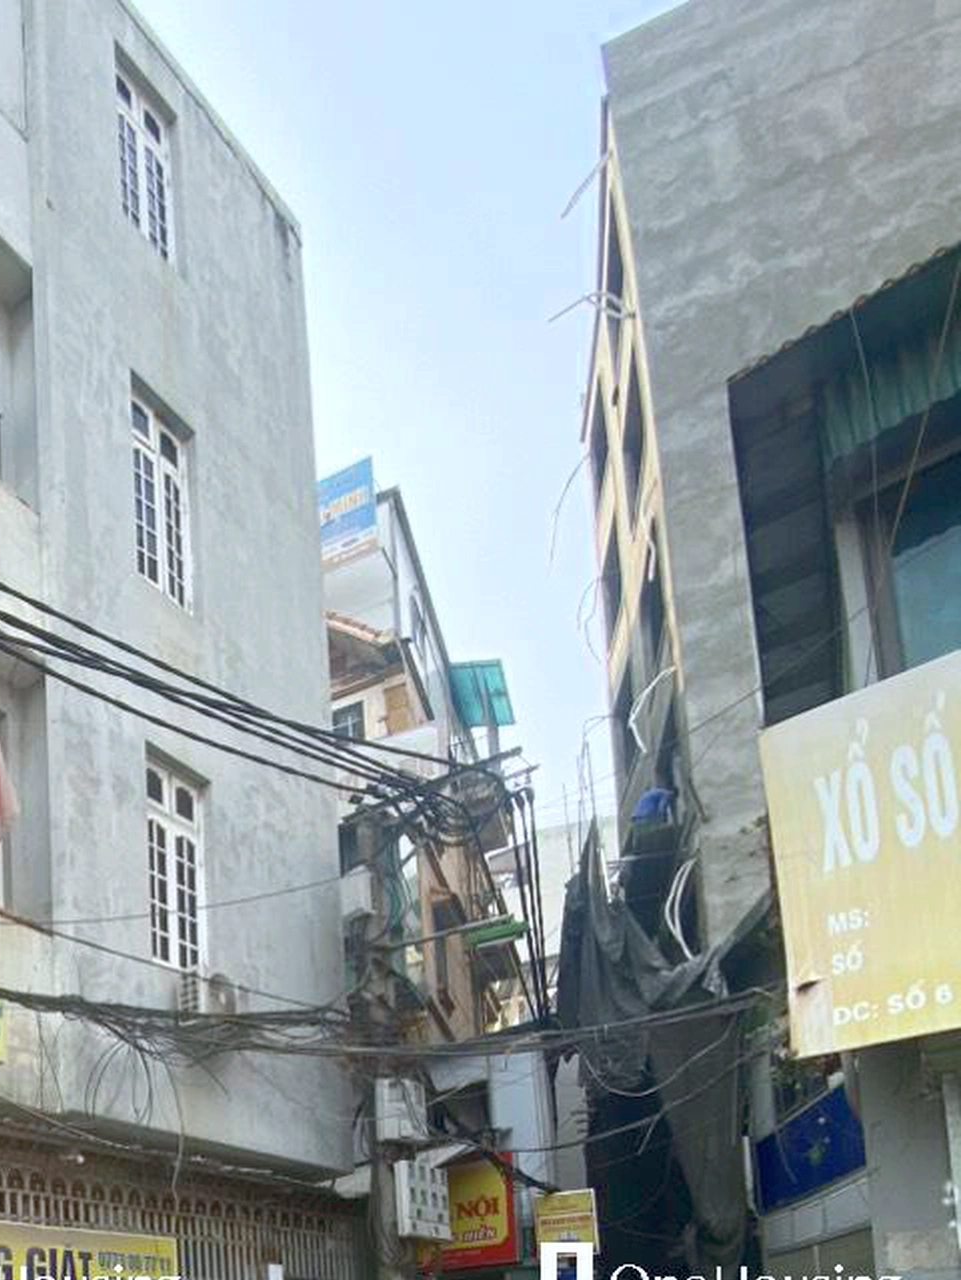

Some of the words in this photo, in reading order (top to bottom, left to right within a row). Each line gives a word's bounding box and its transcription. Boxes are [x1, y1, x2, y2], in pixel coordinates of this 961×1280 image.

[813, 717, 880, 873] XỔ
[890, 691, 959, 848] SỐ
[827, 908, 870, 937] MS:
[934, 983, 953, 1006] 6
